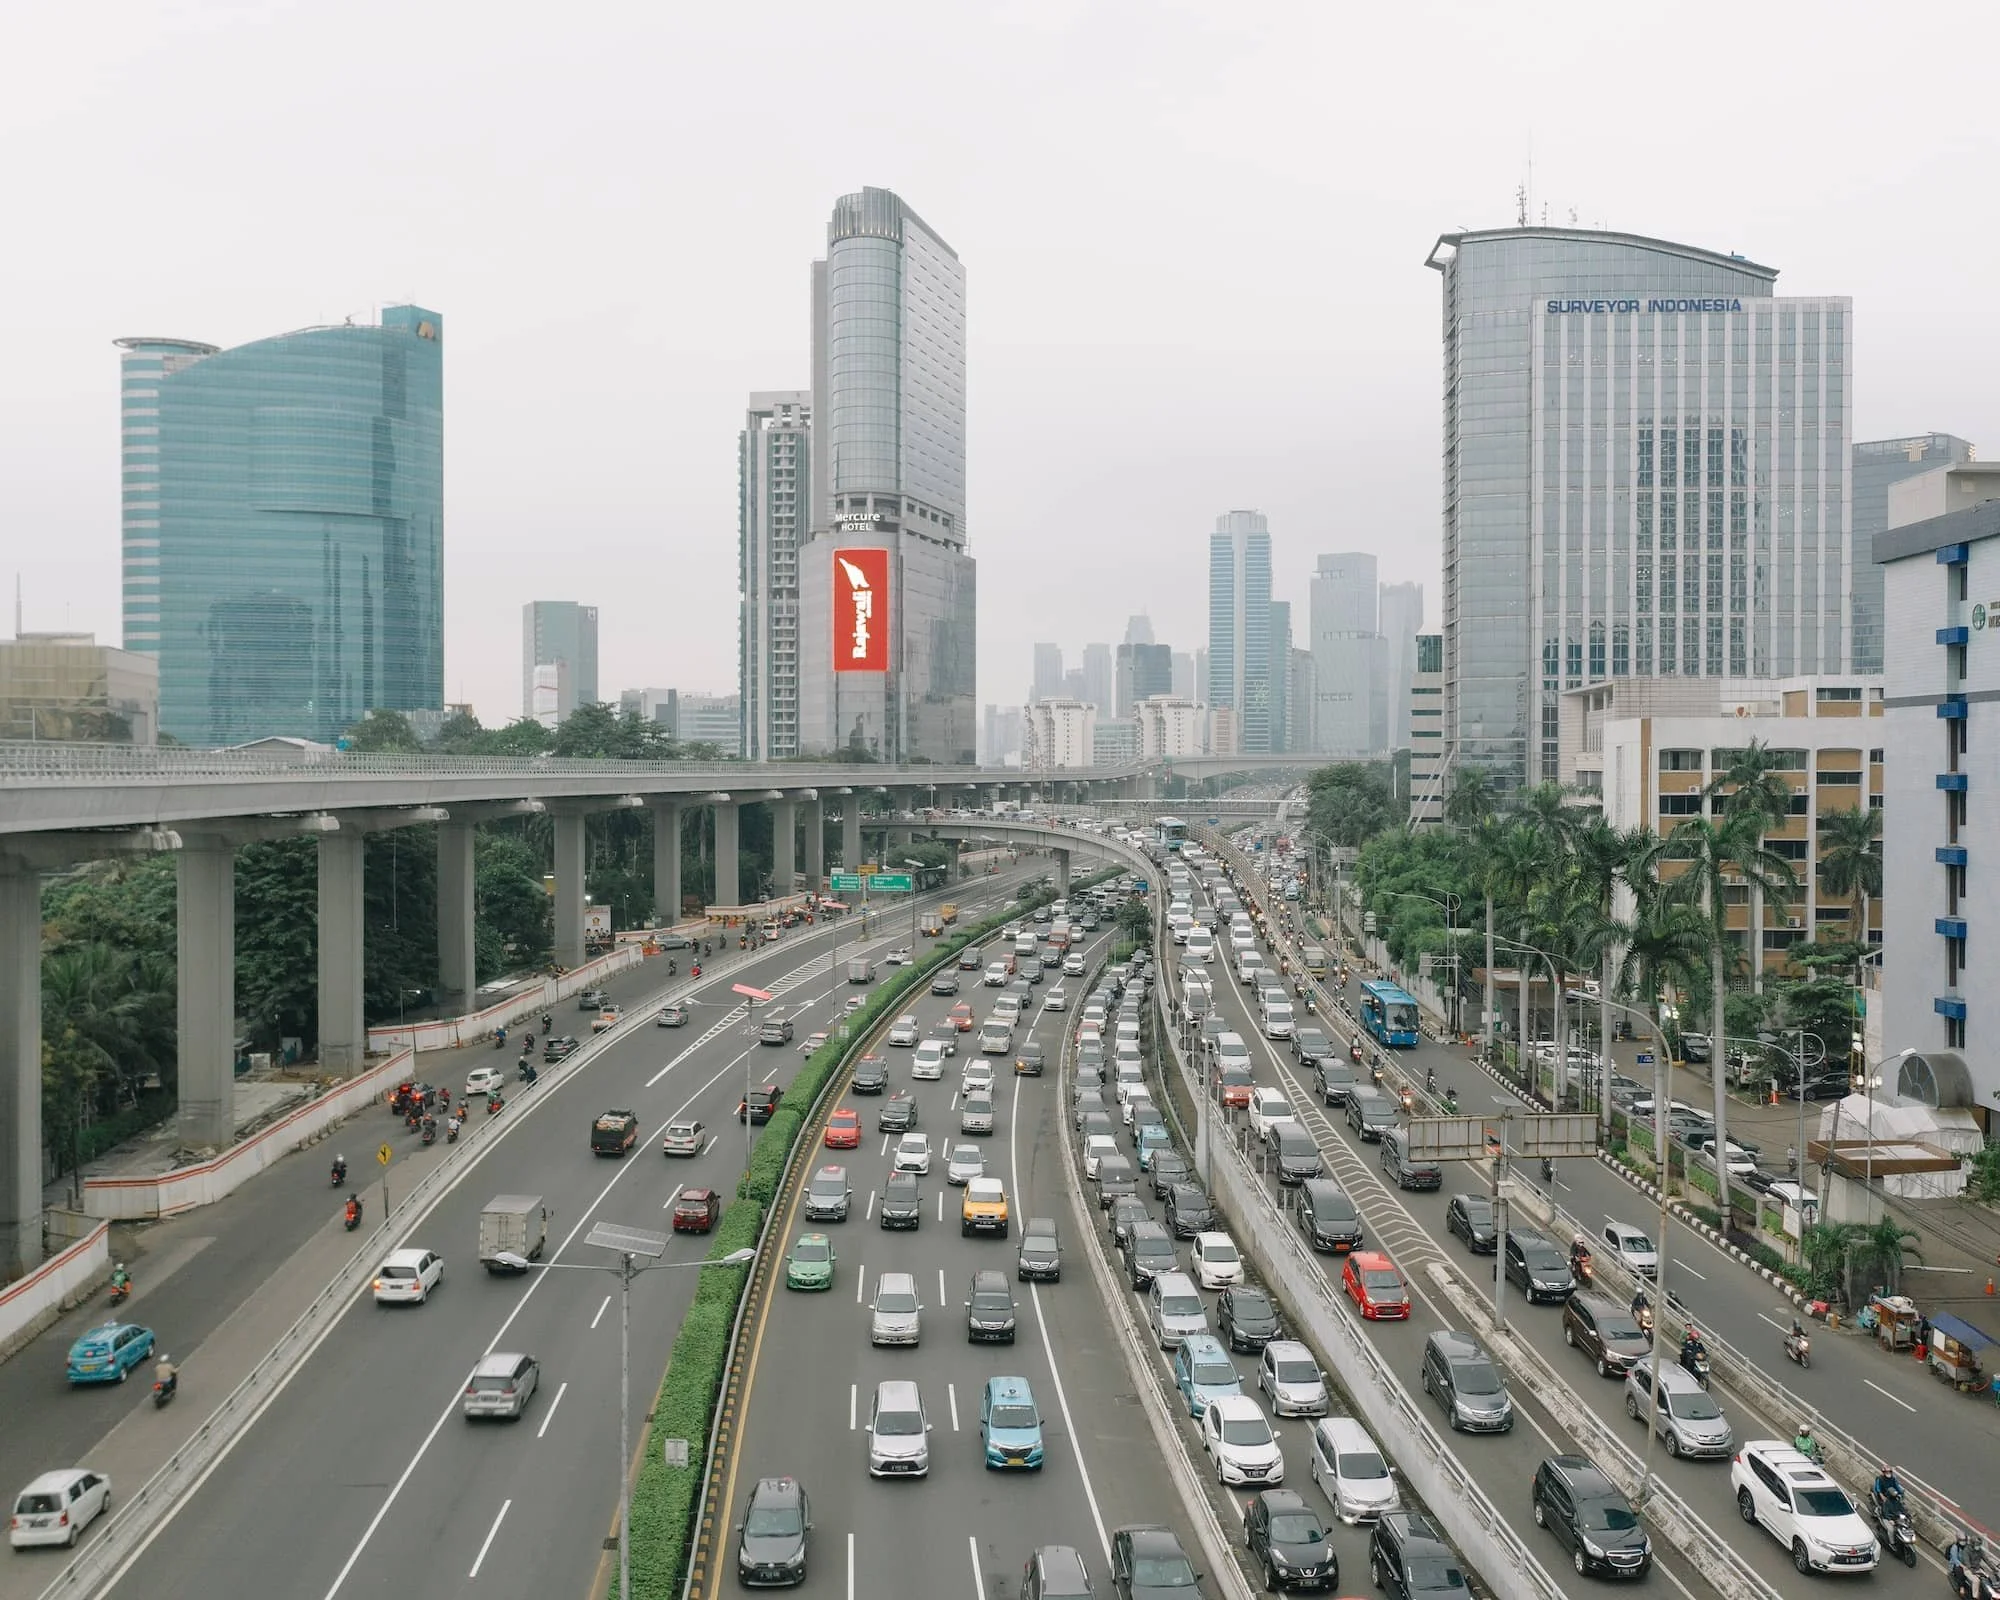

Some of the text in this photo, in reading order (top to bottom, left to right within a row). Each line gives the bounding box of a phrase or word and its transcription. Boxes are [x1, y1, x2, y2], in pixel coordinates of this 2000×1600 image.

[1547, 298, 1742, 314] SURVEYOR INDONESIA
[835, 513, 881, 522] Mercure
[841, 522, 872, 531] HOTEL
